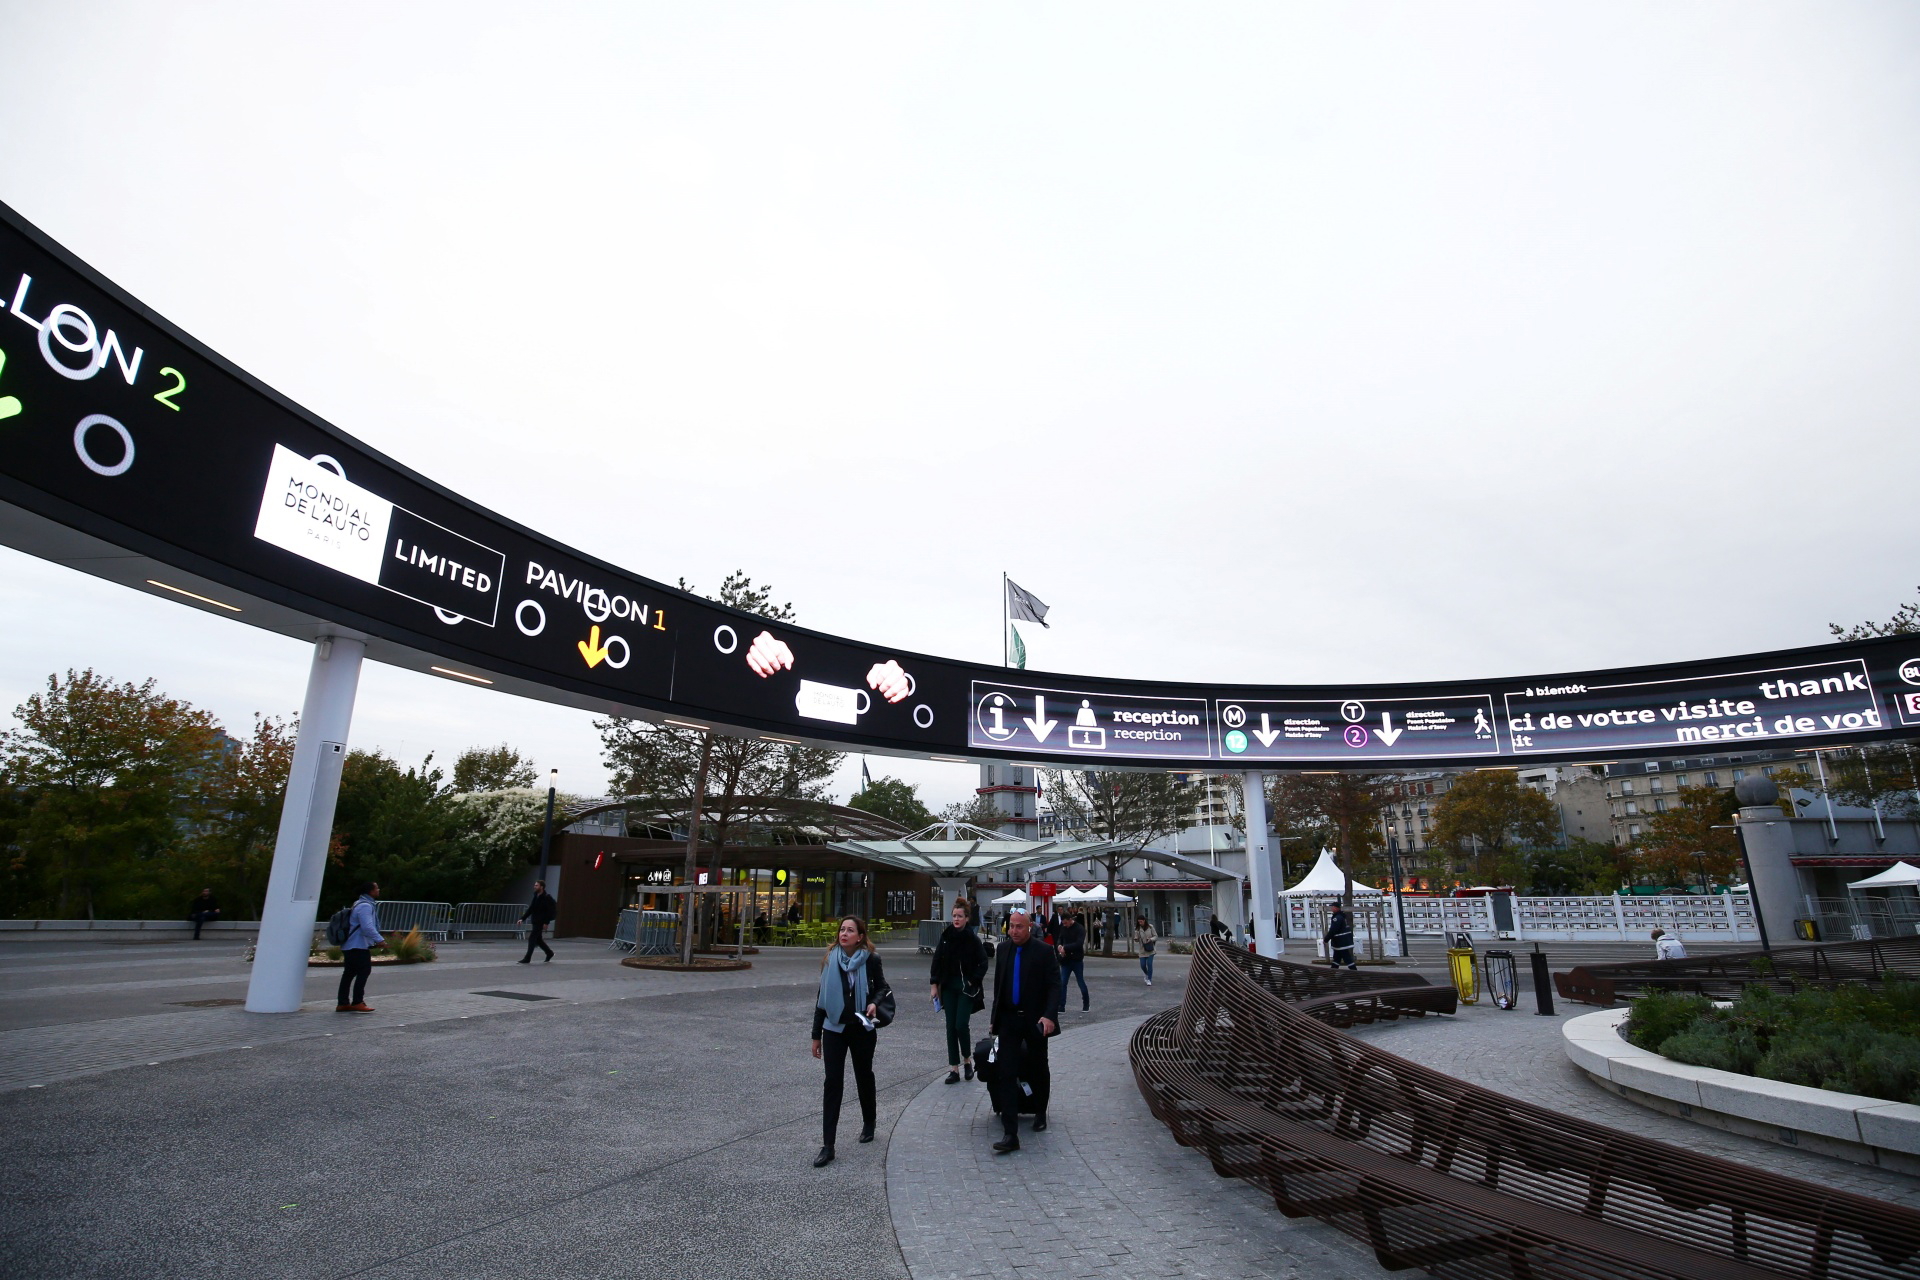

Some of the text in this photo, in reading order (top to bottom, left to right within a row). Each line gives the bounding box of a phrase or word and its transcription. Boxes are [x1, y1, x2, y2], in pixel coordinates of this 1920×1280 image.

[154, 367, 186, 411] 2
[288, 476, 371, 527] MONDIAL
[307, 528, 342, 550] PARIS
[394, 537, 492, 593] LIMITED
[526, 560, 666, 631] PAVILLON 1
[1525, 684, 1588, 697] à bientôt
[1758, 671, 1868, 700] thank
[1113, 709, 1199, 727] reception
[1227, 709, 1241, 723] M
[1346, 705, 1359, 719] T
[1405, 710, 1445, 718] direction
[1539, 712, 1573, 730] de
[1577, 708, 1656, 727] votre
[1660, 698, 1756, 722] visite
[1114, 727, 1182, 742] reception
[1350, 729, 1361, 743] 2
[1675, 716, 1769, 742] merci
[1773, 714, 1816, 734] de
[1227, 735, 1245, 749] 12
